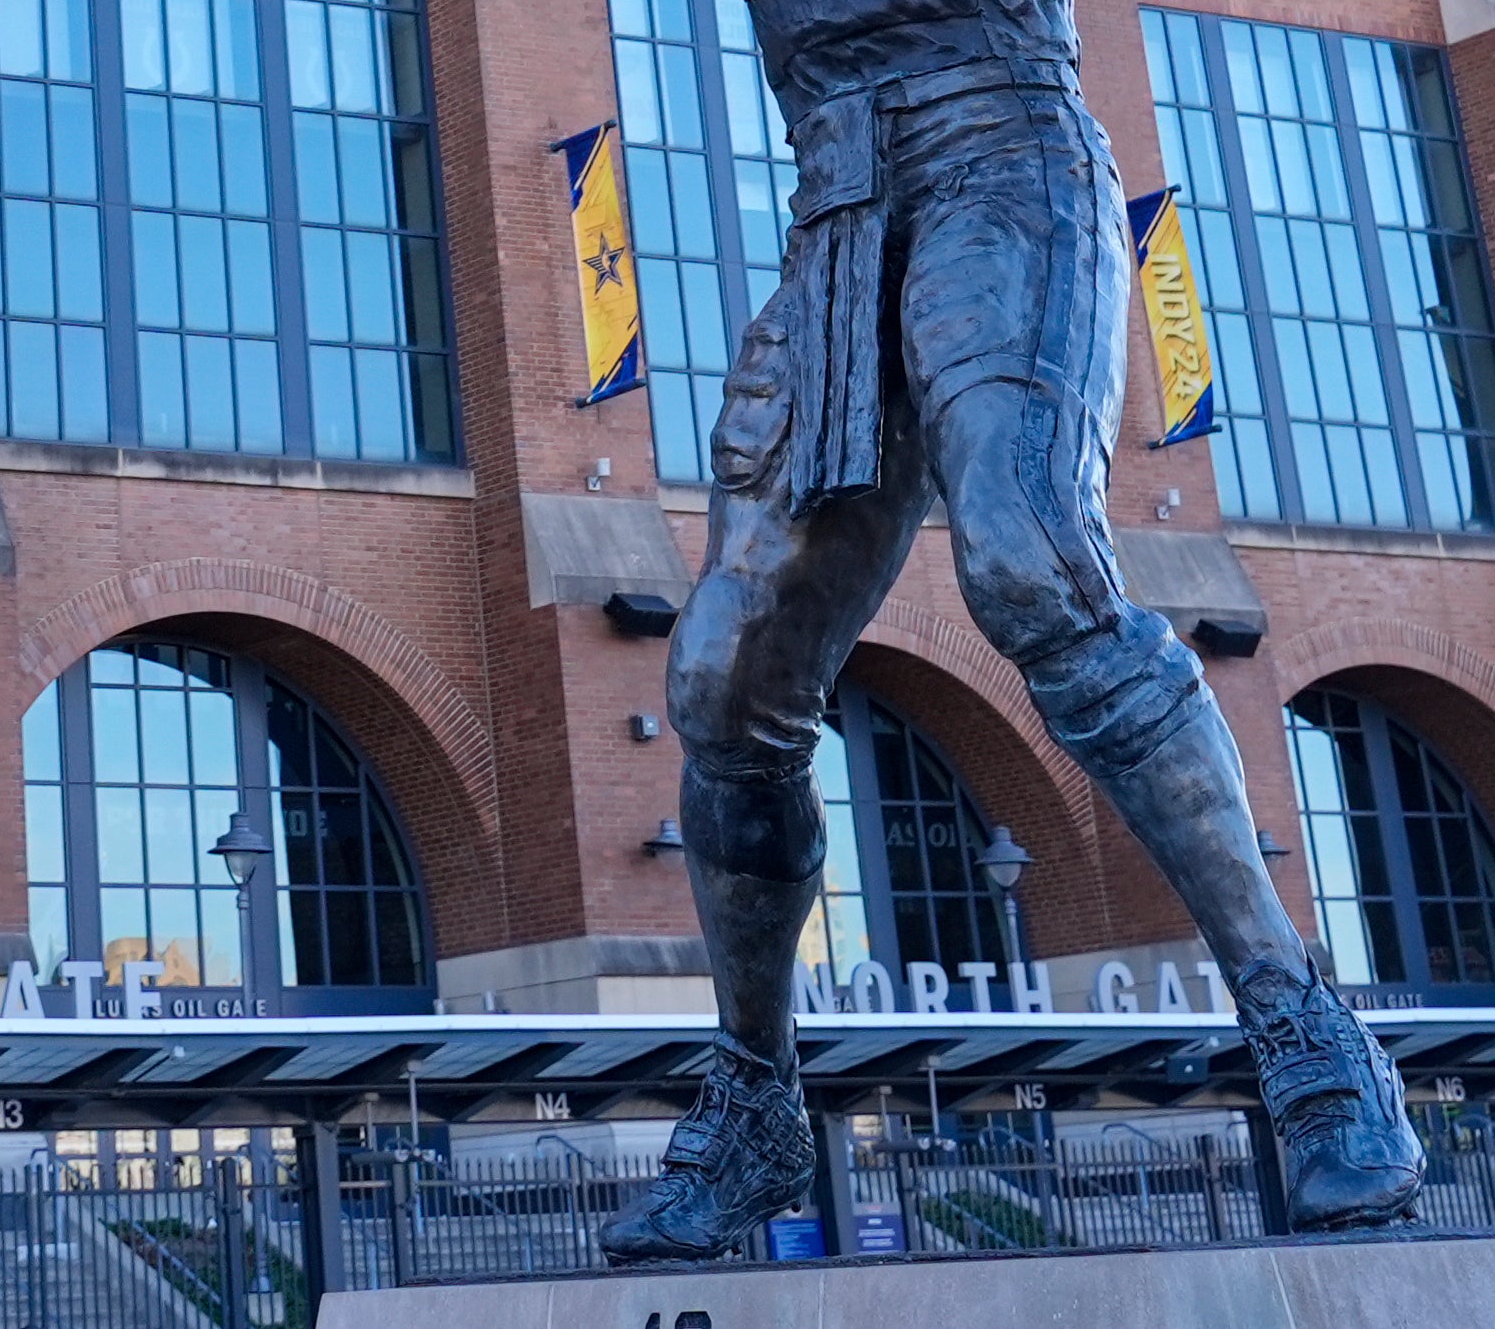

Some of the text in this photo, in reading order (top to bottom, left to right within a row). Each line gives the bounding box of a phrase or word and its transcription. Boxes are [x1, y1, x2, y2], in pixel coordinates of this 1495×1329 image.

[1151, 253, 1204, 399] INDY 24
[793, 961, 1223, 1013] NORTH GAT
[173, 998, 207, 1018] OIL
[217, 998, 267, 1017] GAE
[1355, 993, 1381, 1010] OIL
[1387, 993, 1425, 1009] GATE
[1015, 1082, 1047, 1110] N5
[1436, 1076, 1465, 1103] N6
[535, 1092, 571, 1121] N4
